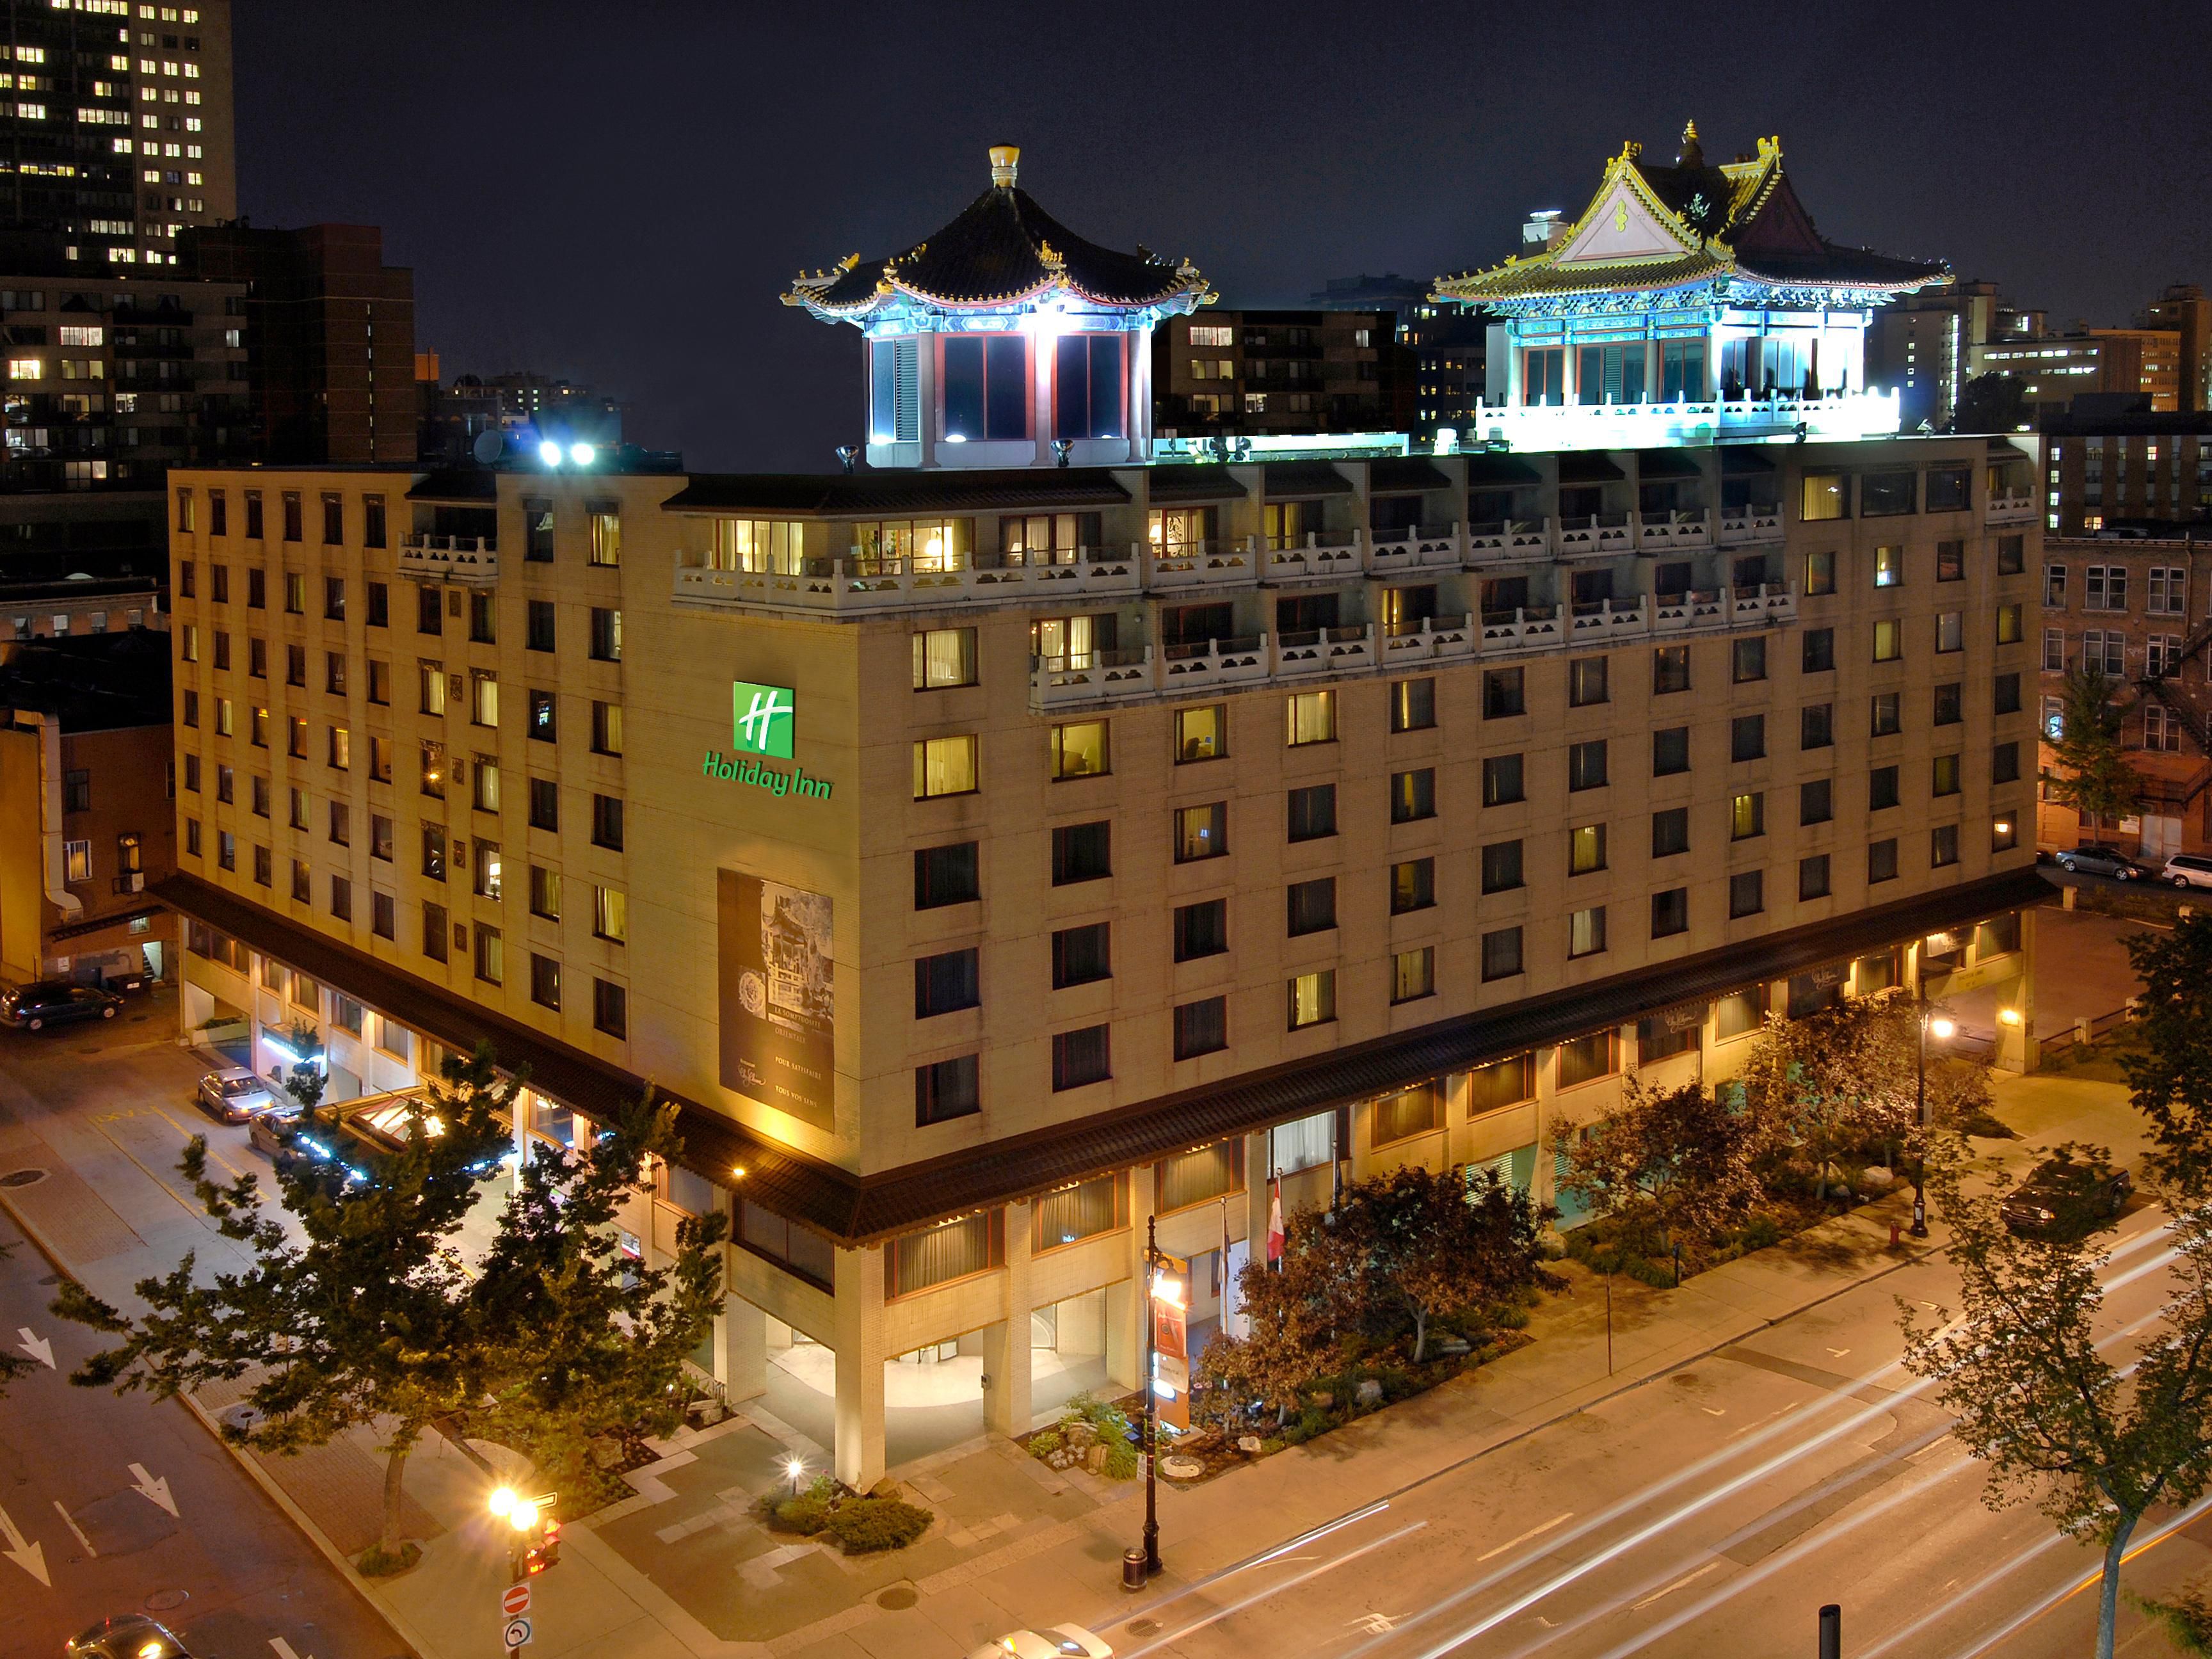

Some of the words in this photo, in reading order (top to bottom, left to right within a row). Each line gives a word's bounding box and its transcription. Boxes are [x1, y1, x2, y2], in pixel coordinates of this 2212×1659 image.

[702, 751, 790, 797] Holiday
[792, 767, 832, 799] Inn
[775, 1056, 790, 1067] POUR
[775, 1085, 790, 1096] TOUS
[791, 1091, 802, 1102] VOS
